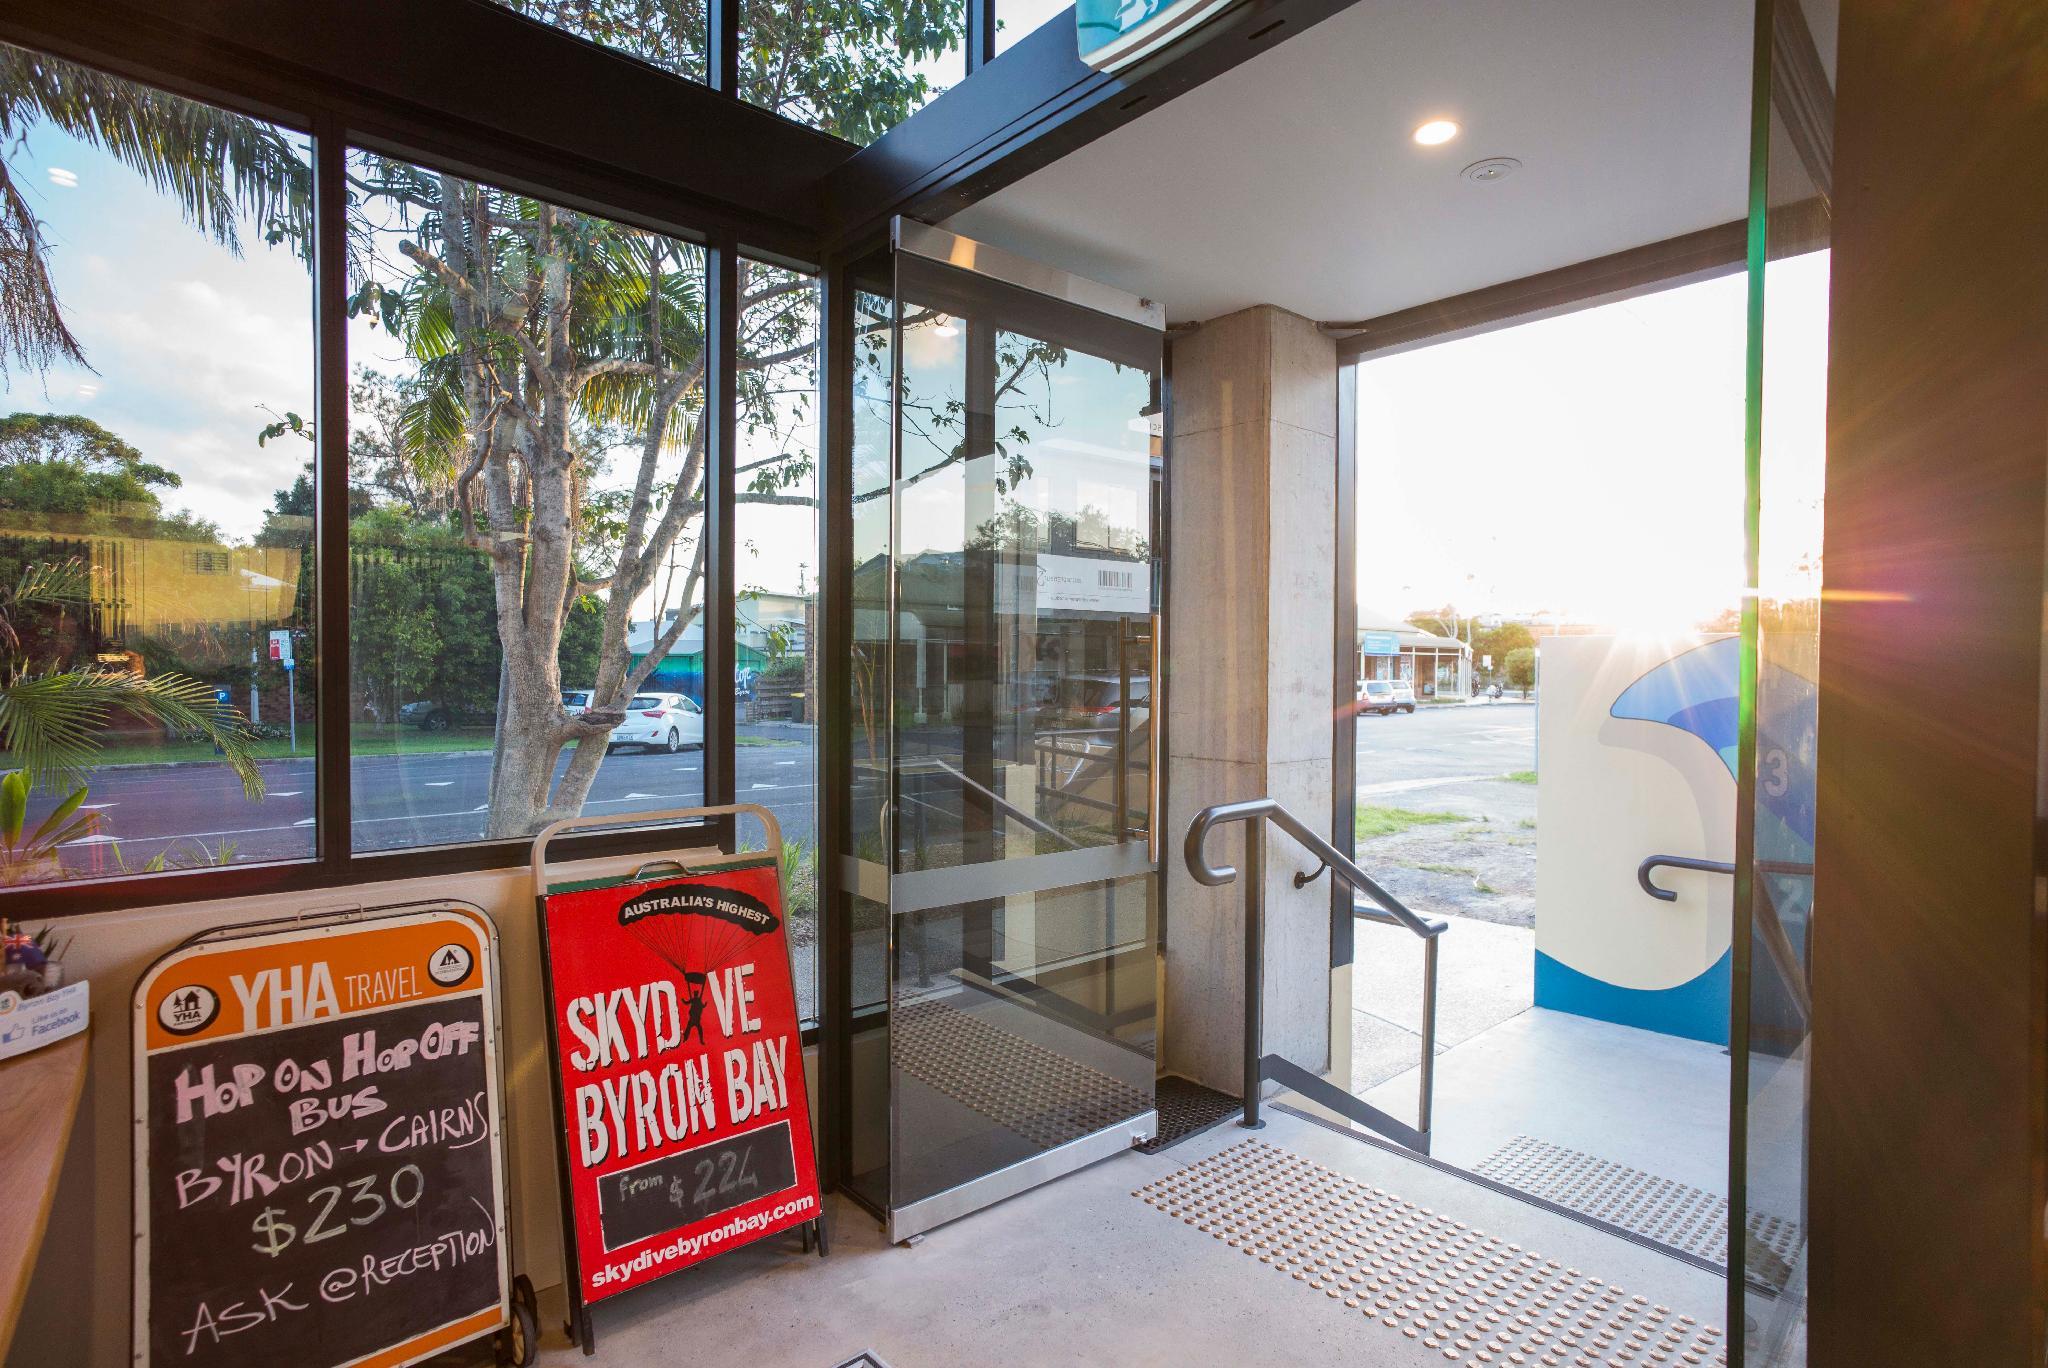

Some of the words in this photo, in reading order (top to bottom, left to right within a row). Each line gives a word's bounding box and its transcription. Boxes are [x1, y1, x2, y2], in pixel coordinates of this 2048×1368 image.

[1765, 748, 1788, 797] 3
[624, 896, 714, 919] AUSTRALIA'S
[716, 901, 770, 926] HIGHEST
[31, 1010, 80, 1036] Facebook
[174, 1011, 201, 1021] YHA
[230, 961, 340, 1032] YHA
[344, 966, 423, 1008] TRAVEL
[290, 1085, 387, 1136] BUS
[575, 1053, 717, 1168] BYRON
[724, 1035, 790, 1124] BAY
[176, 1141, 333, 1209] BYRON
[378, 1091, 488, 1153] CAIRNS
[251, 1163, 424, 1258] $230
[591, 1195, 815, 1289] skydivebyronbay.com
[182, 1283, 309, 1355] ASK
